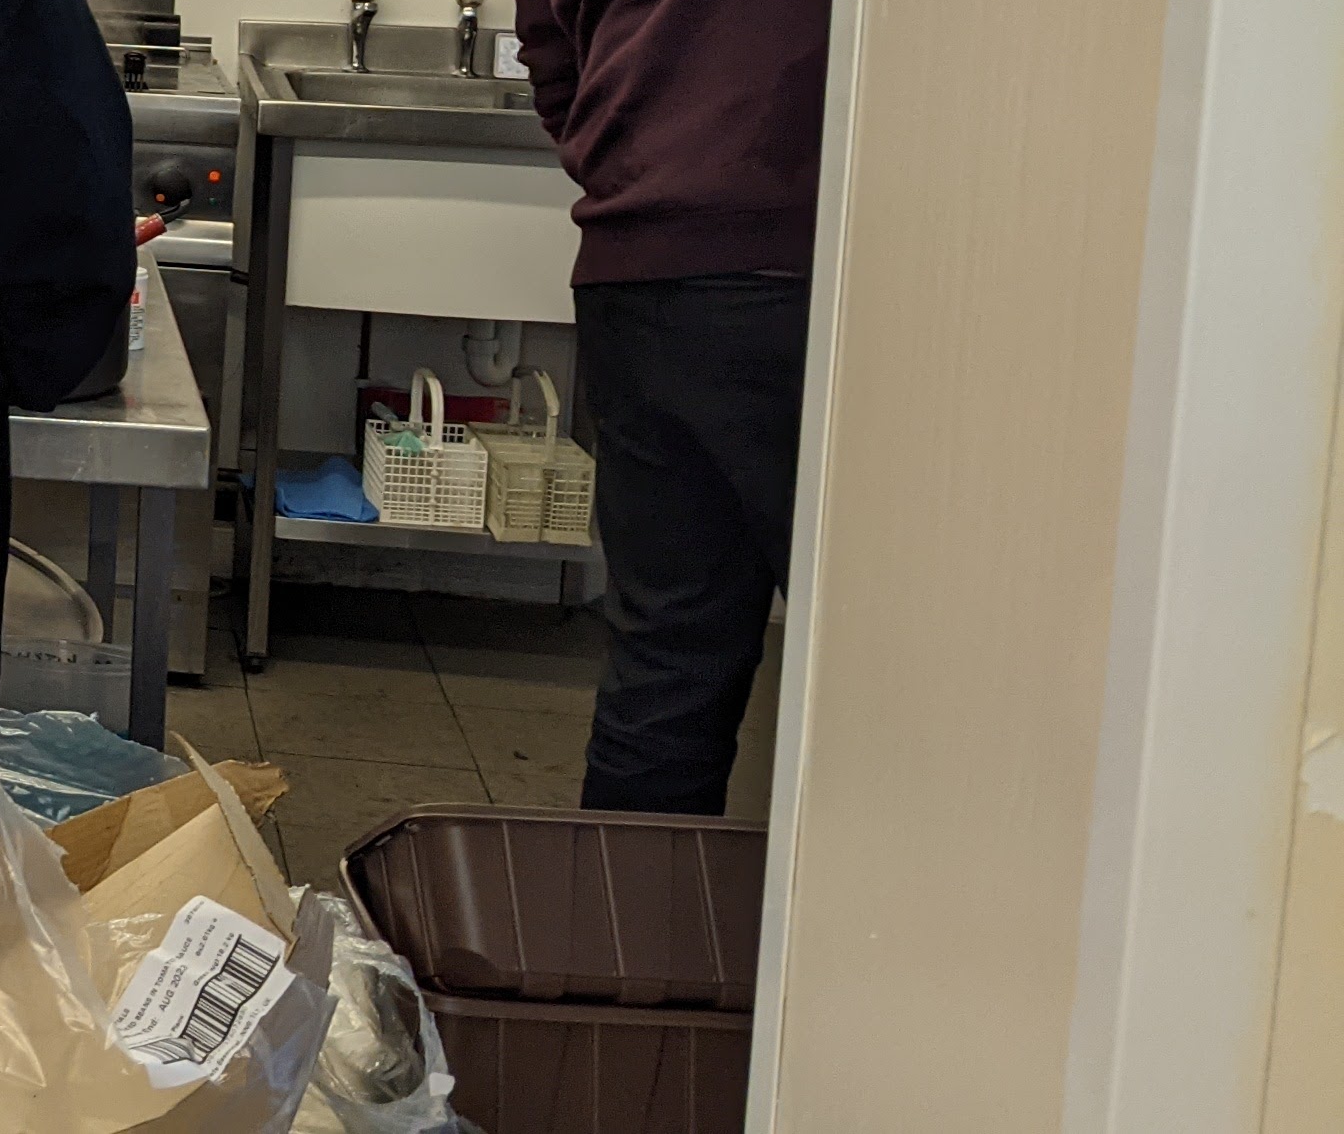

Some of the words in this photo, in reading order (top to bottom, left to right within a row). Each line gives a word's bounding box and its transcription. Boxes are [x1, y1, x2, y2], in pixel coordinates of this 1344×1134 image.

[135, 995, 151, 1022] BEANS
[150, 987, 158, 999] IN
[158, 988, 176, 1013] AUG
